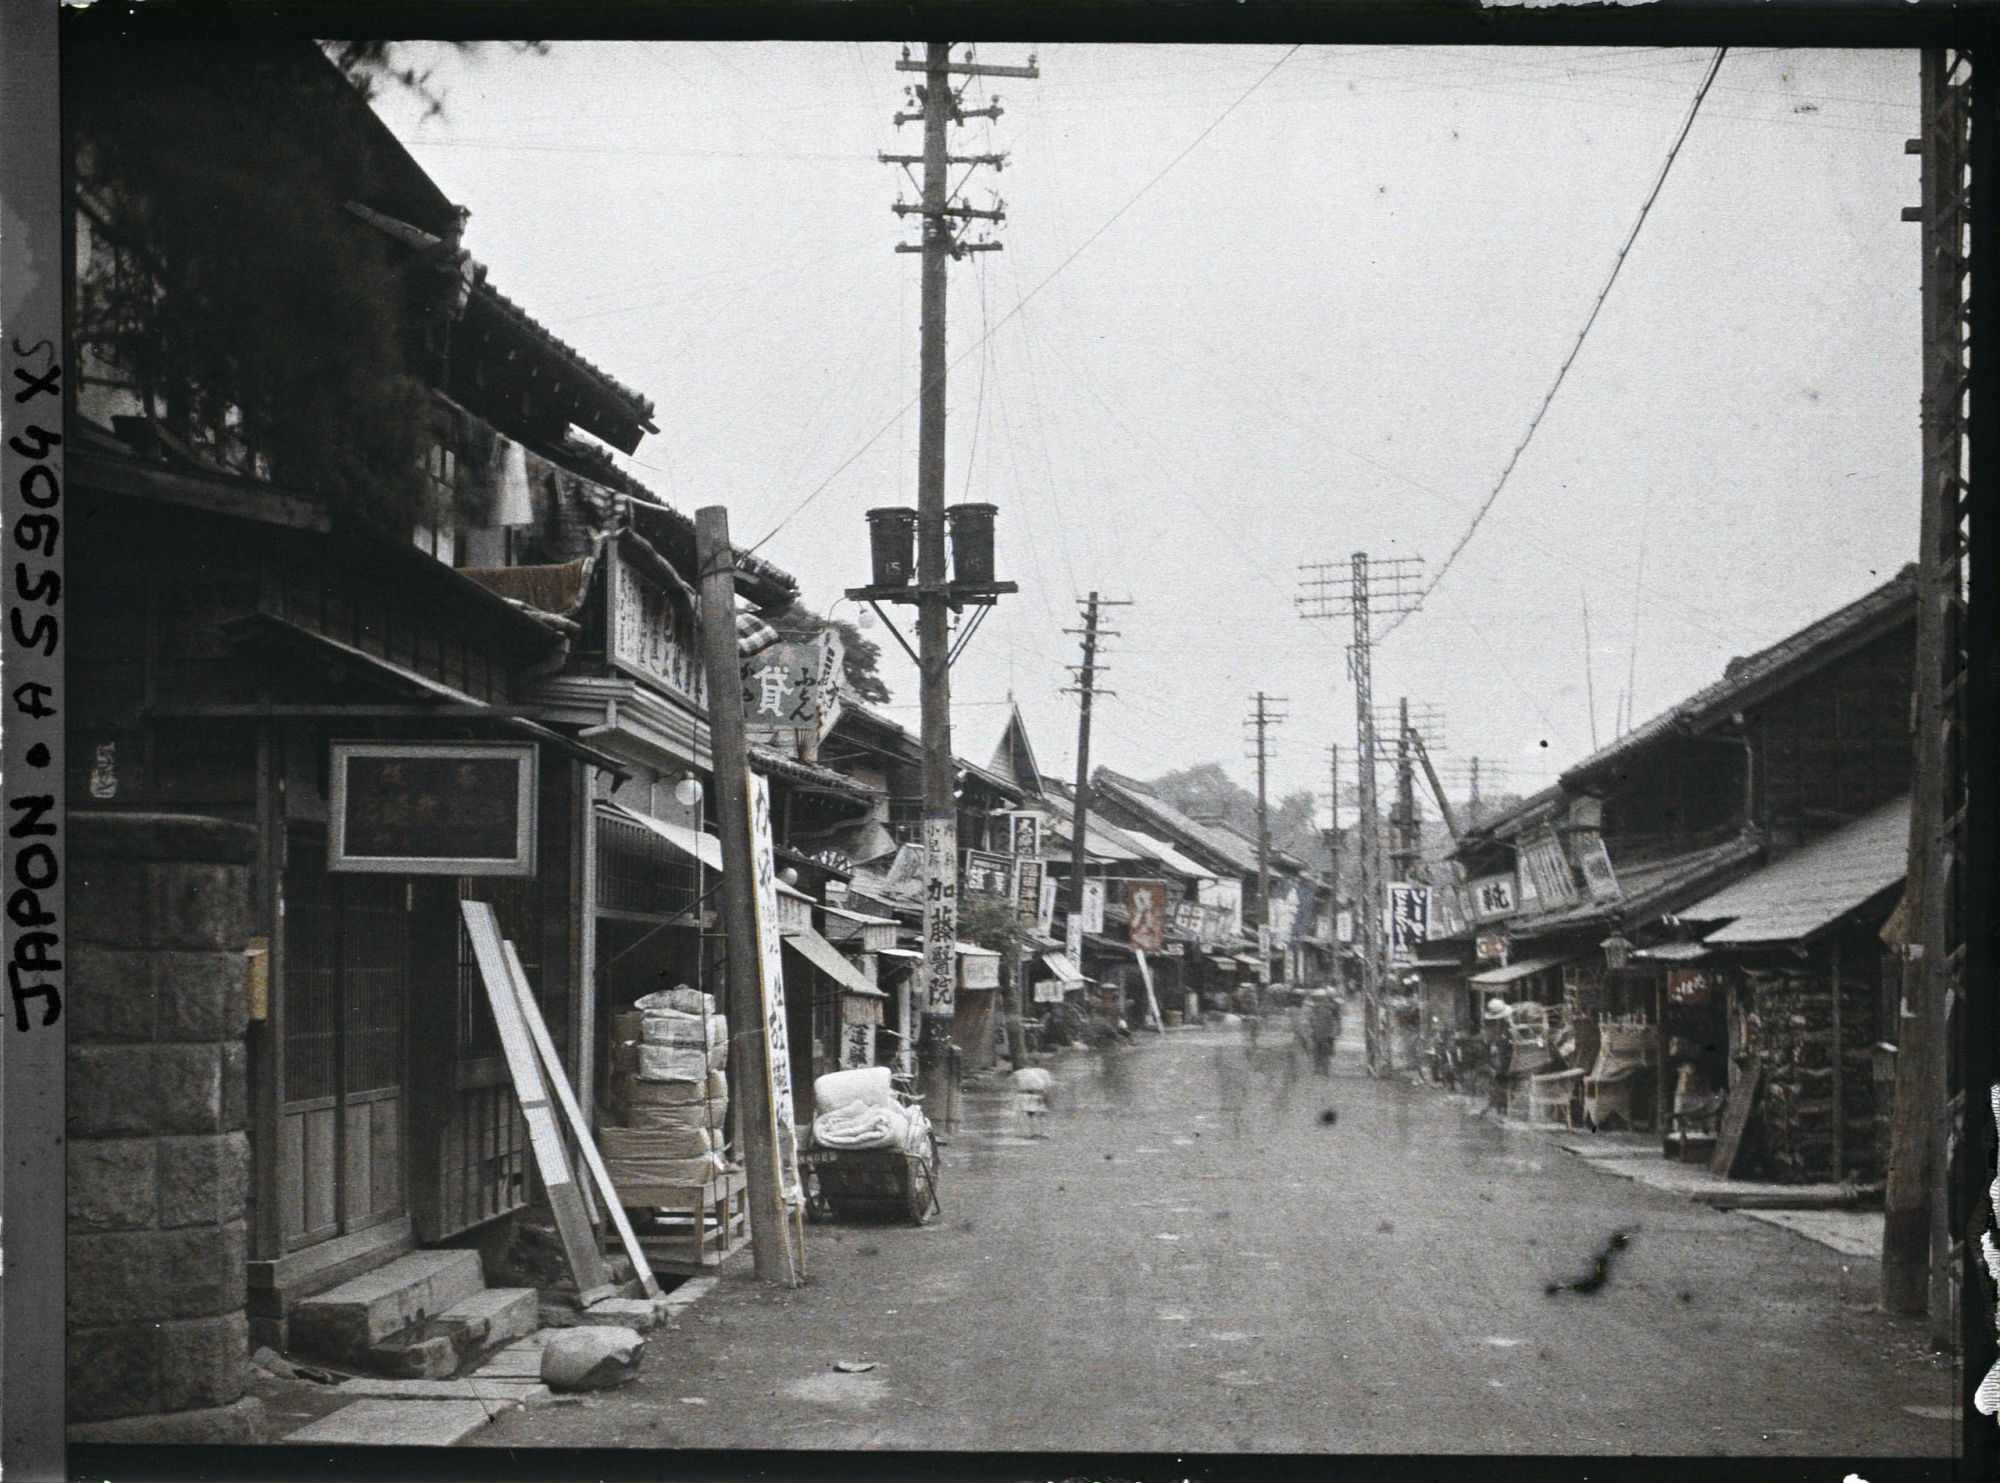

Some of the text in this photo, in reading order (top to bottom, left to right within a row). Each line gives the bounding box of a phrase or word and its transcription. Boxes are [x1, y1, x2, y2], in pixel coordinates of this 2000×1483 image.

[11, 682, 57, 719] A
[752, 665, 794, 717] 貸
[8, 794, 60, 1032] JAPON
